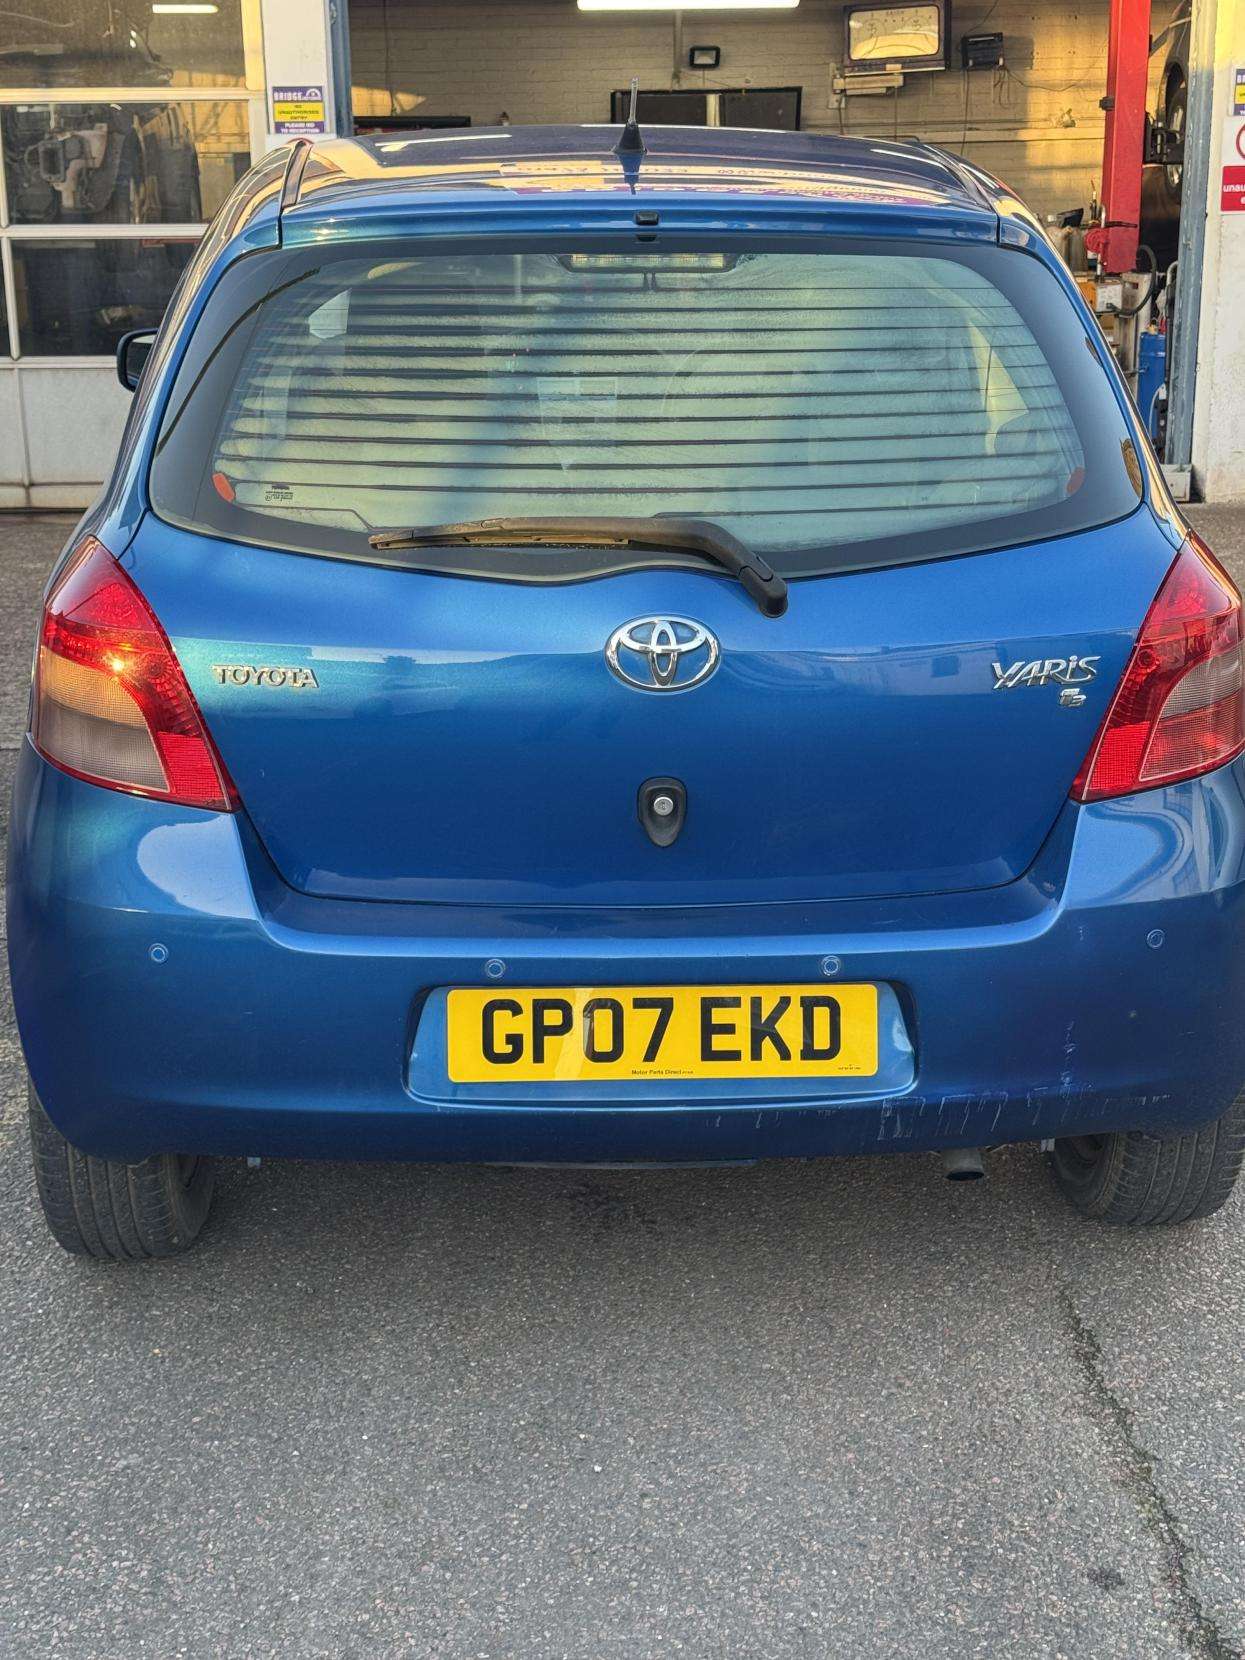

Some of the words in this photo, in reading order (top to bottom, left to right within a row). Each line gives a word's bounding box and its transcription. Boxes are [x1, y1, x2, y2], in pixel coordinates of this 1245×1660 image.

[273, 91, 303, 101] BRIDGE
[212, 664, 319, 688] TOYOTA
[481, 997, 675, 1064] GP07
[700, 995, 841, 1061] EKD
